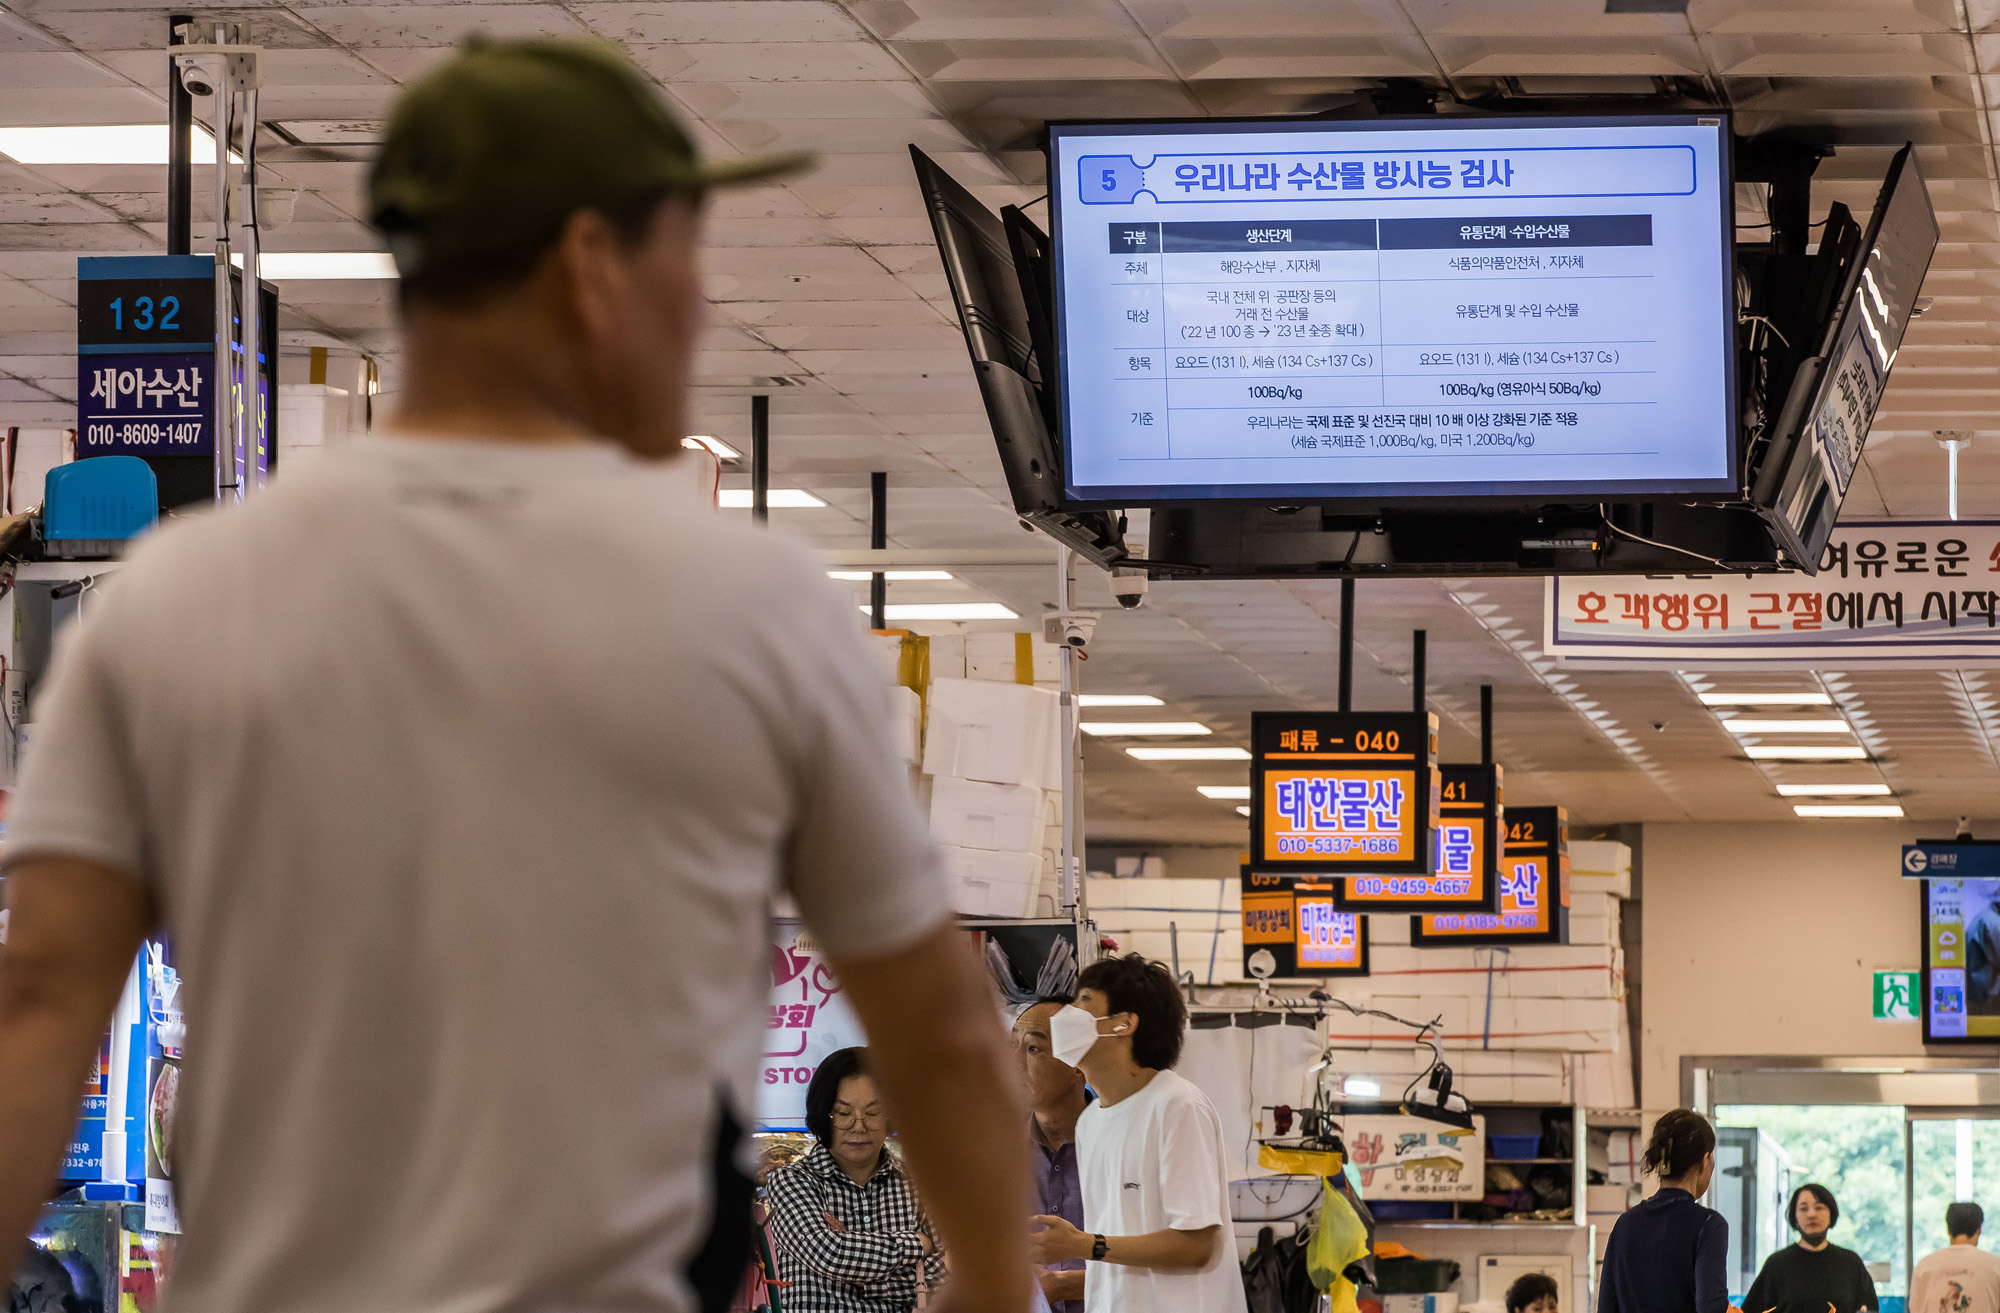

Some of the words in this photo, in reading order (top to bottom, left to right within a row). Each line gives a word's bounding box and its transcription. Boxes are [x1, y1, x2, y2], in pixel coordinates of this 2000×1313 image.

[1101, 169, 1117, 191] 5
[1175, 163, 1280, 192] 우리나라
[1287, 161, 1365, 191] 수산물
[1374, 160, 1452, 190] 방사능
[1460, 158, 1514, 188] 검사
[1123, 230, 1147, 245] 구분
[1246, 228, 1292, 243] 생산단계
[1460, 225, 1506, 240] 유통단계
[1124, 261, 1148, 275] 주체
[1286, 258, 1321, 273] 지자체
[1549, 254, 1584, 269] 지자체
[1207, 291, 1229, 304] 국내
[1233, 290, 1255, 304] 전체
[1259, 290, 1270, 303] 위
[1313, 289, 1336, 303] 등의
[110, 296, 180, 330] 132
[1127, 309, 1149, 323] 대상
[1235, 307, 1258, 321] 거래
[1261, 307, 1272, 321] 전
[1275, 307, 1309, 321] 수산물
[1455, 304, 1502, 319] 유통단계
[1504, 304, 1516, 318] 및
[1518, 303, 1542, 318] 수입
[1544, 303, 1580, 317] 수산물
[1205, 325, 1216, 339] 년
[1220, 325, 1241, 338] 100
[1243, 325, 1255, 339] 종
[1294, 324, 1305, 337] 년
[1128, 357, 1151, 371] 항목
[1175, 356, 1209, 368] 요오드
[1252, 355, 1275, 369] 세슘
[1419, 353, 1453, 365] 요오드
[1497, 351, 1520, 366] 세슘
[90, 367, 202, 409] 세아수산
[1248, 385, 1302, 400] 100Bq/kg
[1439, 382, 1494, 397] 100Bq/kg
[1497, 382, 1546, 397] (영유아식
[1549, 381, 1601, 397] 50Bq/kg)
[1131, 412, 1154, 426] 기준
[1247, 415, 1303, 430] 우리나라는
[1306, 415, 1329, 429] 국제
[1332, 415, 1355, 429] 표준
[1358, 414, 1369, 428] 및
[1372, 414, 1406, 428] 선진국
[1409, 414, 1432, 427] 대비
[1435, 414, 1450, 426] 10
[1452, 413, 1463, 427] 배
[1467, 413, 1489, 427] 이상
[1492, 412, 1527, 427] 강화된
[1529, 412, 1552, 426] 기준
[1555, 411, 1578, 426] 적용
[88, 423, 201, 445] 010-8609-1407
[1291, 434, 1318, 449] (세슘
[1321, 434, 1365, 449] 국제표준
[1440, 433, 1463, 447] 미국
[1466, 432, 1535, 448] 1,200Bq/kg)
[1817, 539, 1970, 578] 여유로운
[1574, 591, 1729, 631] 호객행위
[1747, 591, 1903, 630] 근절에서
[1280, 730, 1319, 751] 패류
[1355, 730, 1399, 751] 040
[1444, 782, 1466, 800] 41
[1276, 779, 1404, 830] 태한물산
[1278, 837, 1399, 854] 010-5337-1686
[1356, 877, 1471, 895] 010-9459-4667
[82, 1100, 107, 1109] 사용가
